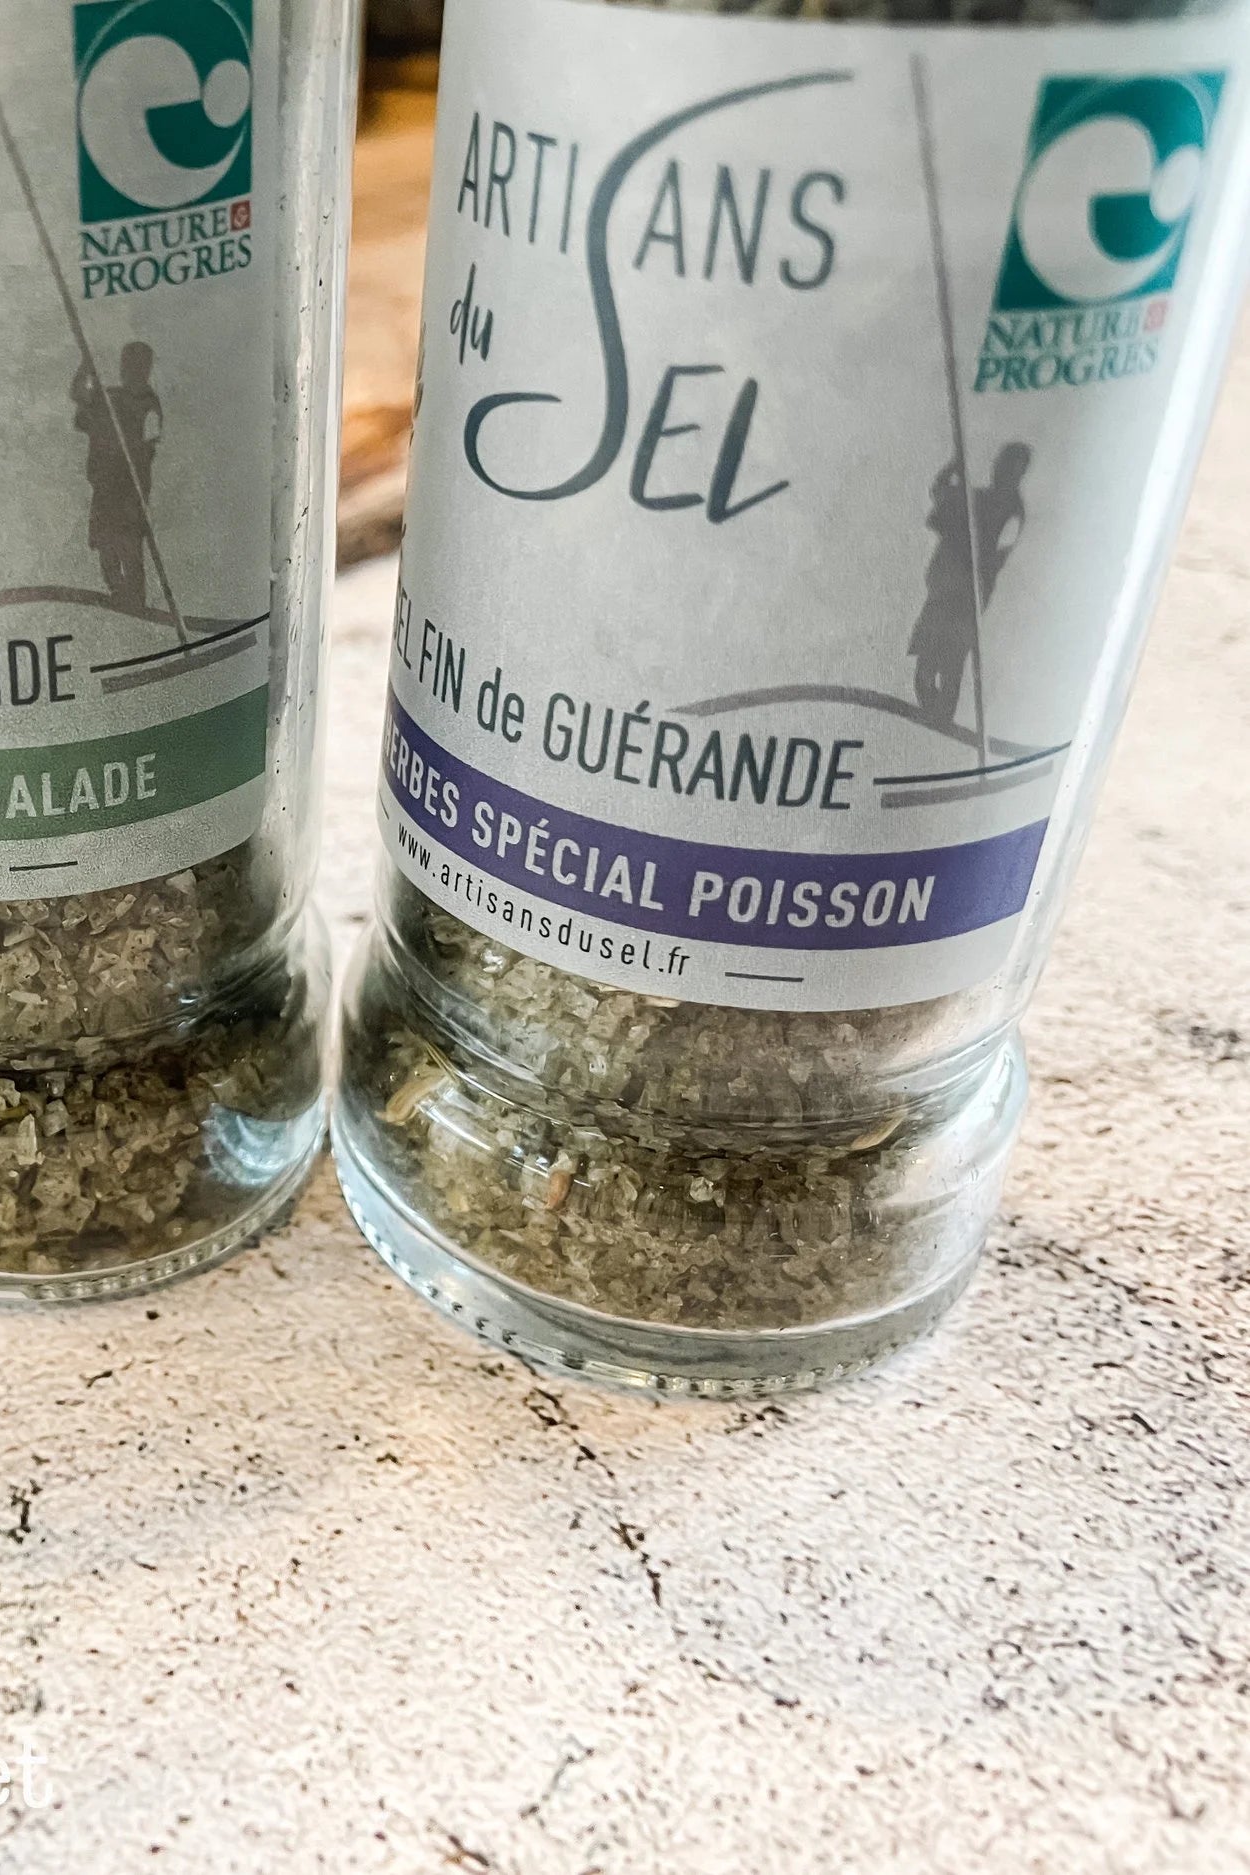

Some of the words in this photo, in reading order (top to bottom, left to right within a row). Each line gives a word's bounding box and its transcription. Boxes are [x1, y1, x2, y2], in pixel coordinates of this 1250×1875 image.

[80, 207, 228, 260] NATURE
[82, 234, 252, 299] PROGRES
[450, 262, 493, 366] du
[419, 618, 465, 713] FIN
[477, 667, 524, 743] de
[543, 692, 864, 810] GUÉRANDE
[398, 822, 690, 977] www.artisansdusel.fr
[471, 801, 664, 912] SPÉCIAL
[688, 871, 936, 928] POISSON
